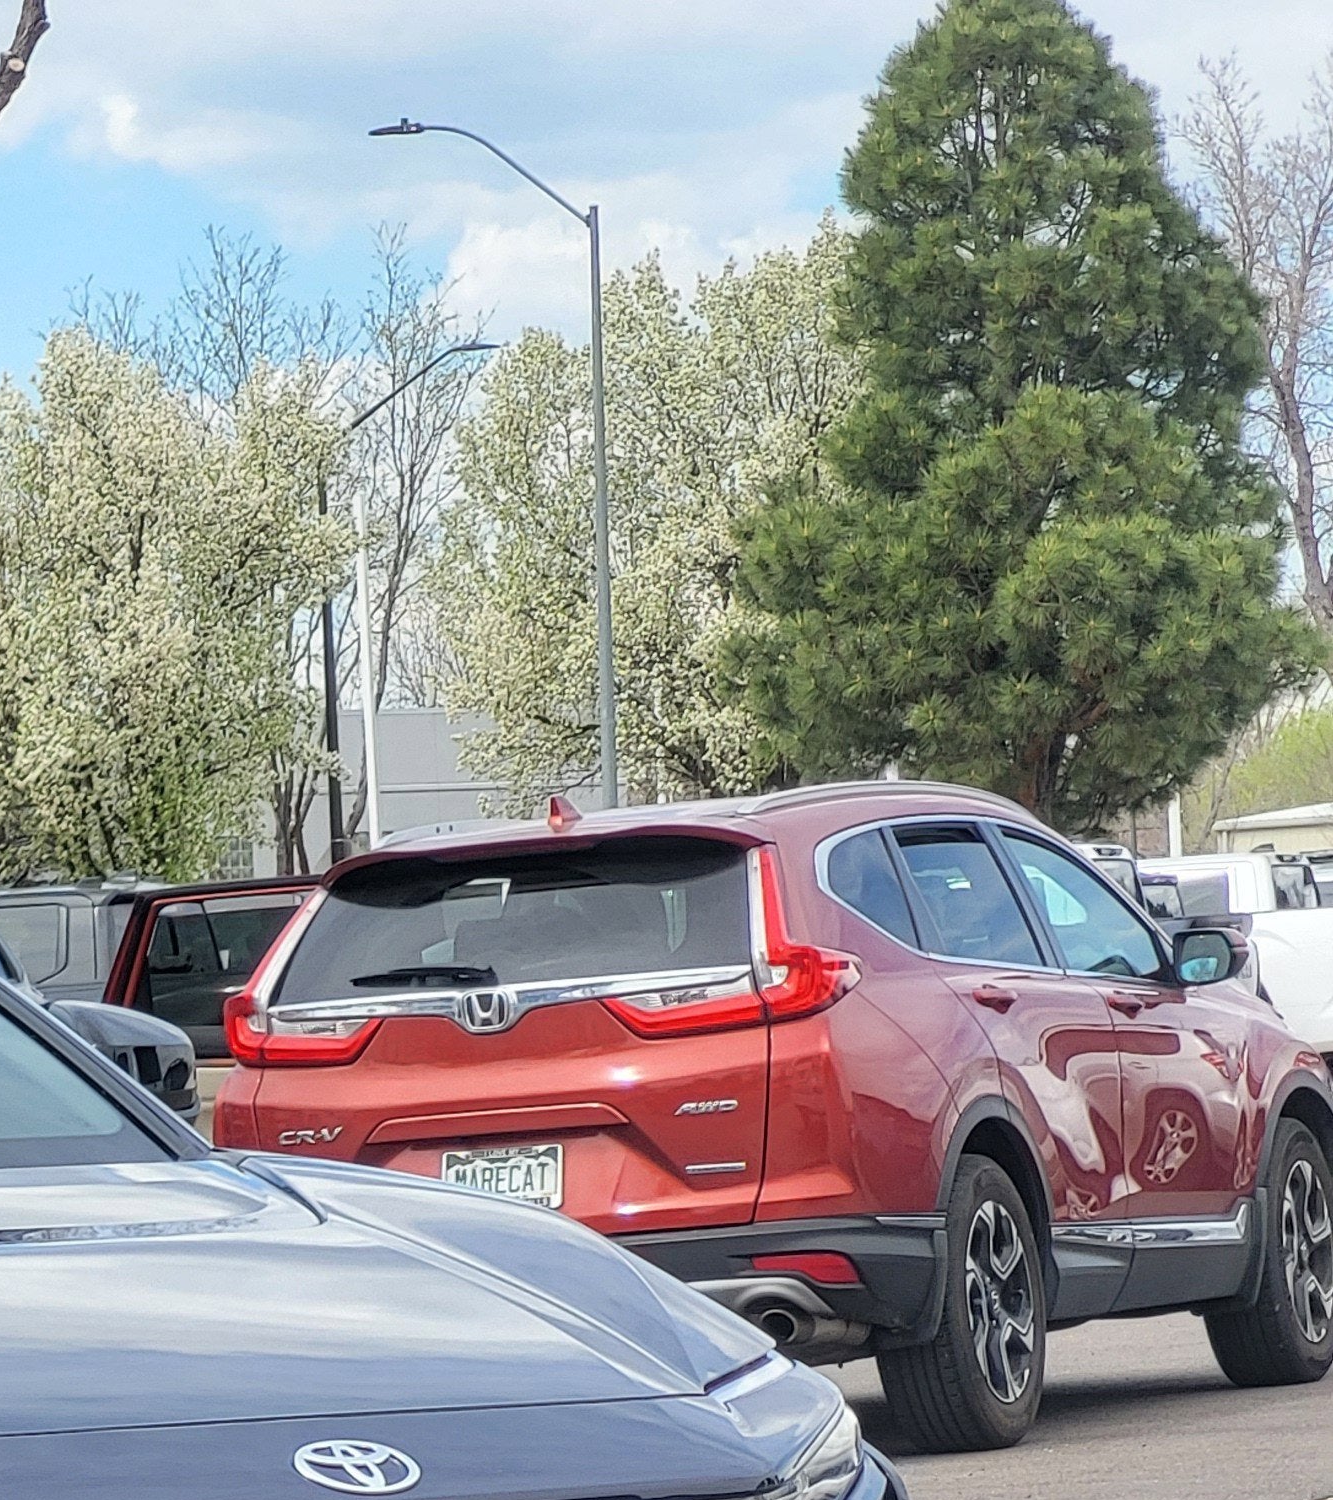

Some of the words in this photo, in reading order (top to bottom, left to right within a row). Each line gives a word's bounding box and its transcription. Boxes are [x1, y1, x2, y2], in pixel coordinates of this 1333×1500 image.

[674, 1099, 739, 1116] AWD
[278, 1126, 343, 1146] CR-V
[455, 1162, 550, 1194] MARECAT
